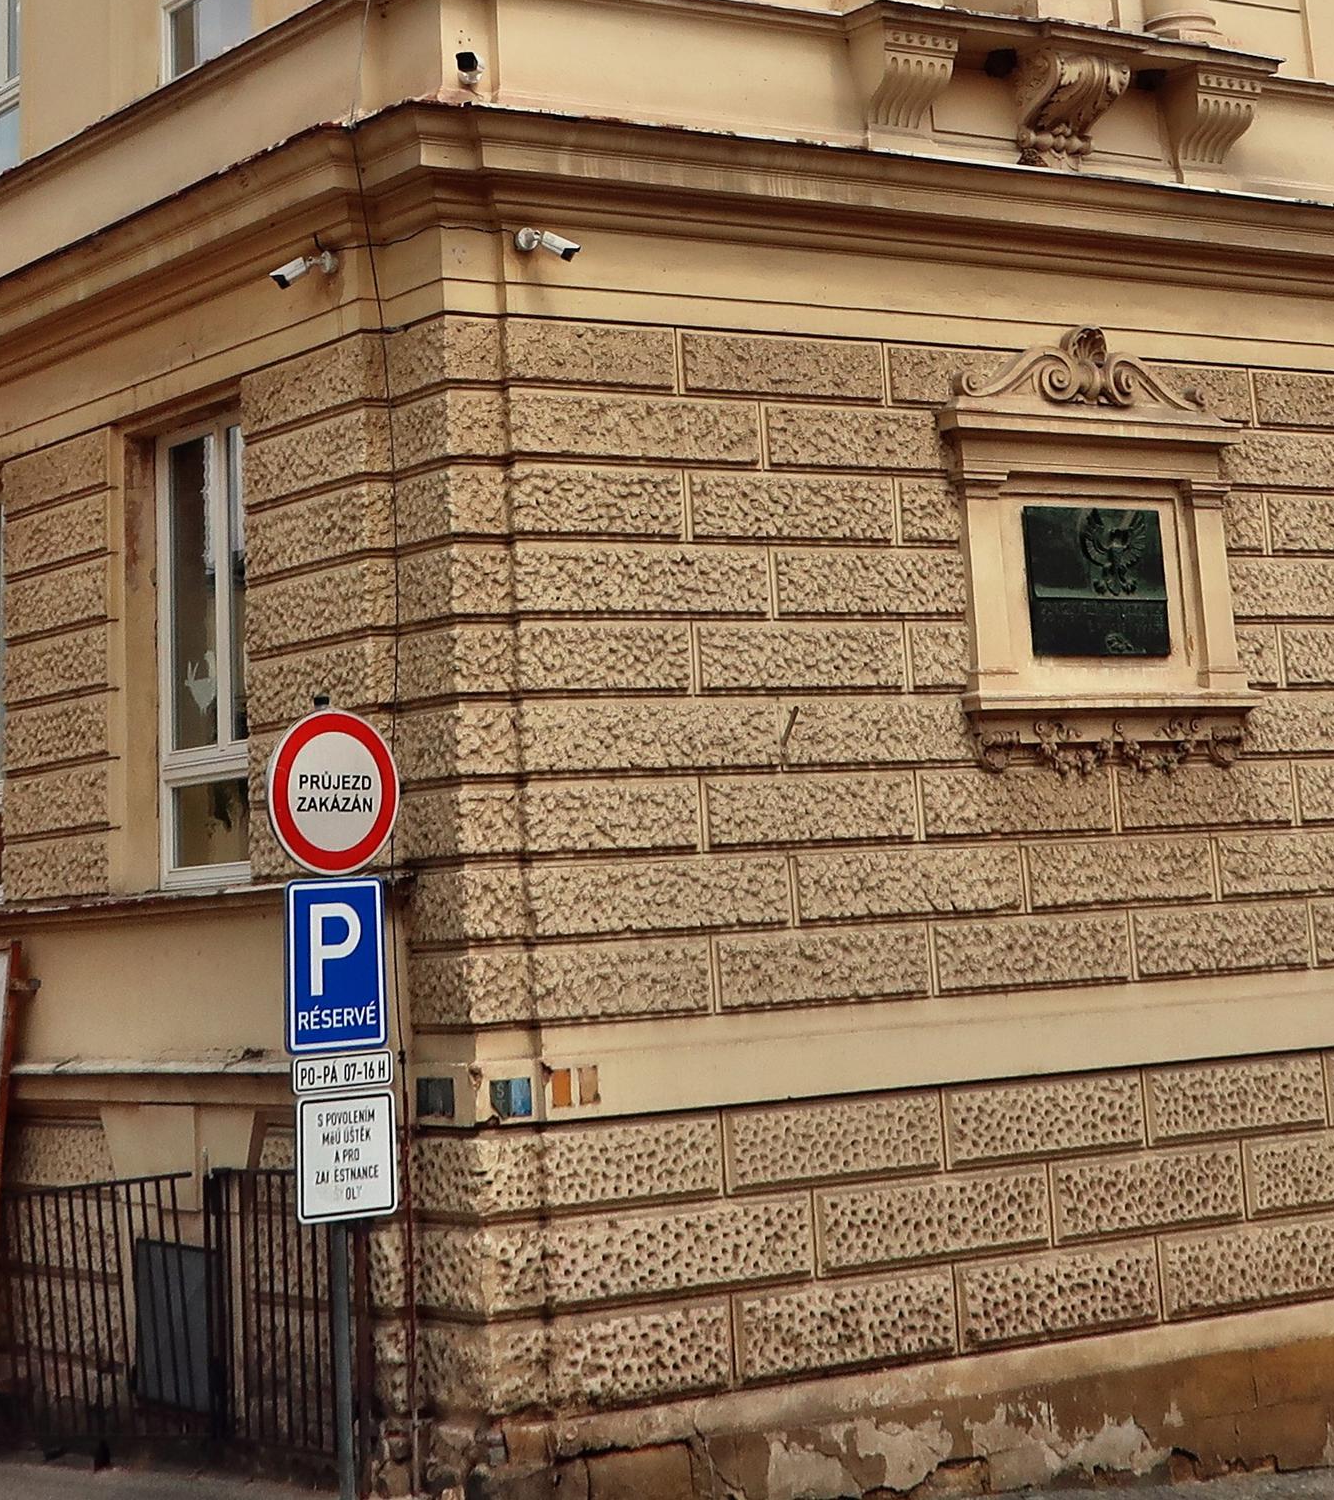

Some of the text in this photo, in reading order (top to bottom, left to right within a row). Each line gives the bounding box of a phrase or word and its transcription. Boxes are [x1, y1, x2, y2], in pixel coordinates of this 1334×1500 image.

[299, 770, 372, 790] PRŮJEZD
[296, 793, 373, 813] ZAKÁZÁN
[309, 902, 361, 997] P
[298, 1000, 377, 1031] RÉSERVÉ
[300, 1059, 386, 1087] PO-PÁ 07-16 H
[317, 1104, 376, 1128] S POVOLENÍM
[343, 1125, 371, 1143] ÚŠTĚK
[334, 1147, 360, 1163] A PRO
